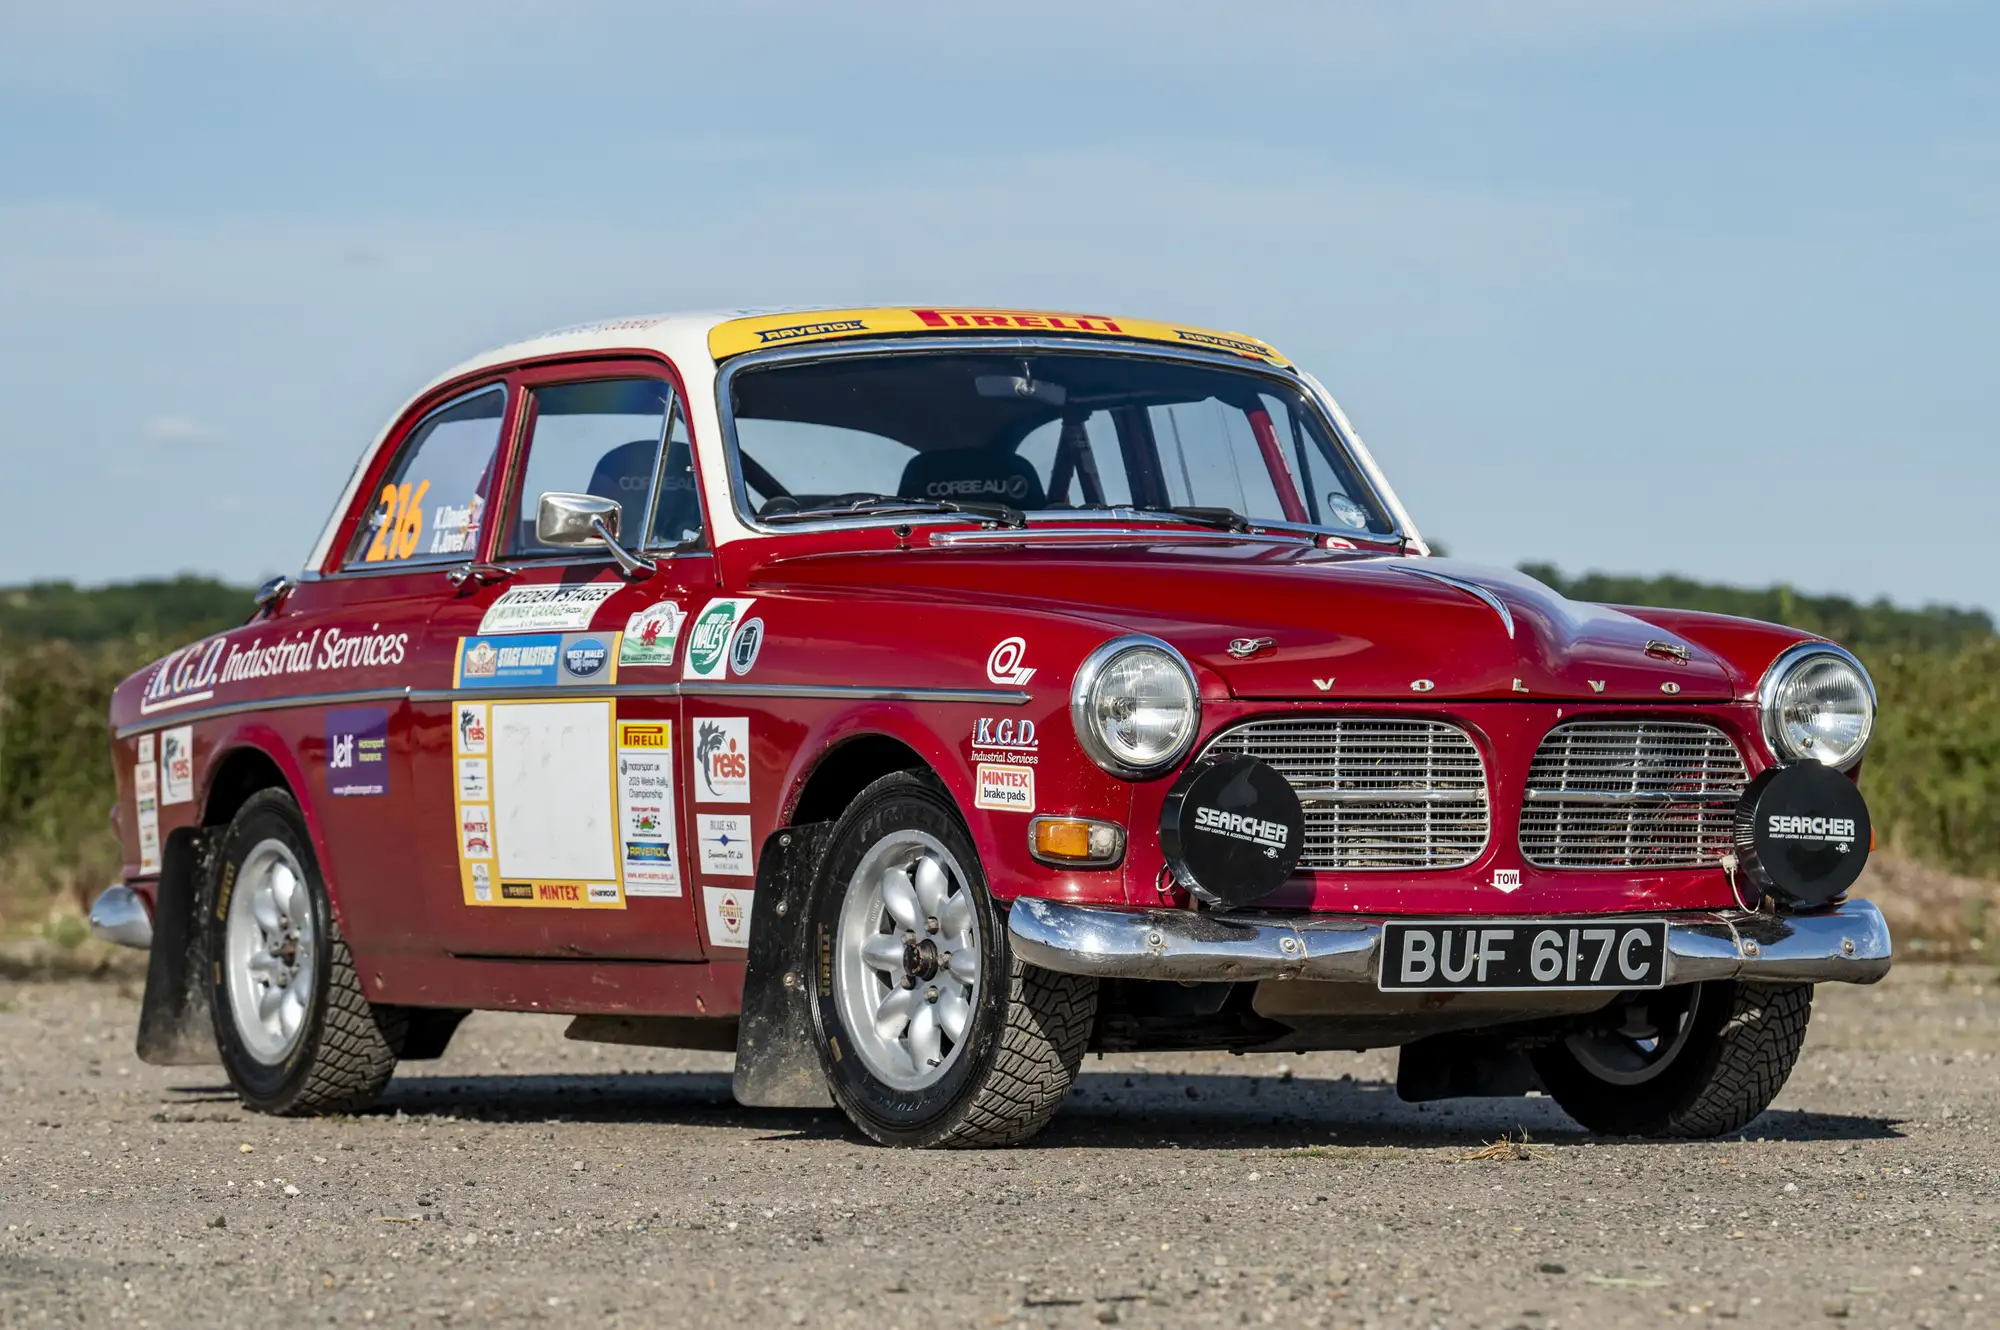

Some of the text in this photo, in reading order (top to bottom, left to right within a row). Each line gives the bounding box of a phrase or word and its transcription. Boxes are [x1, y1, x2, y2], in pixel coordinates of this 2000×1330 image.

[910, 309, 1123, 332] PIRELLI
[764, 322, 861, 341] RAVENOL
[1184, 333, 1266, 354] RAVENOL
[926, 480, 1007, 496] CORBEAU
[365, 479, 431, 562] 216
[498, 586, 617, 605] WYEDEAN STAGES
[497, 607, 531, 620] WINNER
[532, 604, 565, 618] GARAGE
[148, 637, 227, 699] K.G.D.
[219, 628, 322, 683] Industrial
[317, 622, 408, 671] Services
[498, 647, 519, 667] STAGE
[520, 645, 557, 666] MASTERS
[567, 649, 604, 659] WEST WALES
[623, 726, 663, 746] PIRELLI
[976, 718, 1039, 746] K.G.D.
[330, 734, 354, 769] Jelf
[712, 738, 746, 778] reis
[971, 750, 1039, 768] Industrial Services
[628, 762, 661, 773] motorsport uk
[628, 776, 668, 788] 2019 Welsh Rally
[982, 770, 1028, 791] MINTEX
[628, 788, 663, 800] Championship
[984, 788, 1026, 802] brake pads
[463, 822, 488, 833] MINTEX
[710, 820, 737, 831] BLUE SKY
[1195, 806, 1289, 842] SEARCHER
[1768, 815, 1856, 836] SEARCHER
[629, 845, 667, 858] RAVENOL
[1496, 873, 1518, 886] TOW
[539, 885, 580, 901] MINTEX
[719, 905, 744, 920] PENRITE
[1400, 928, 1653, 983] BUF 617C
